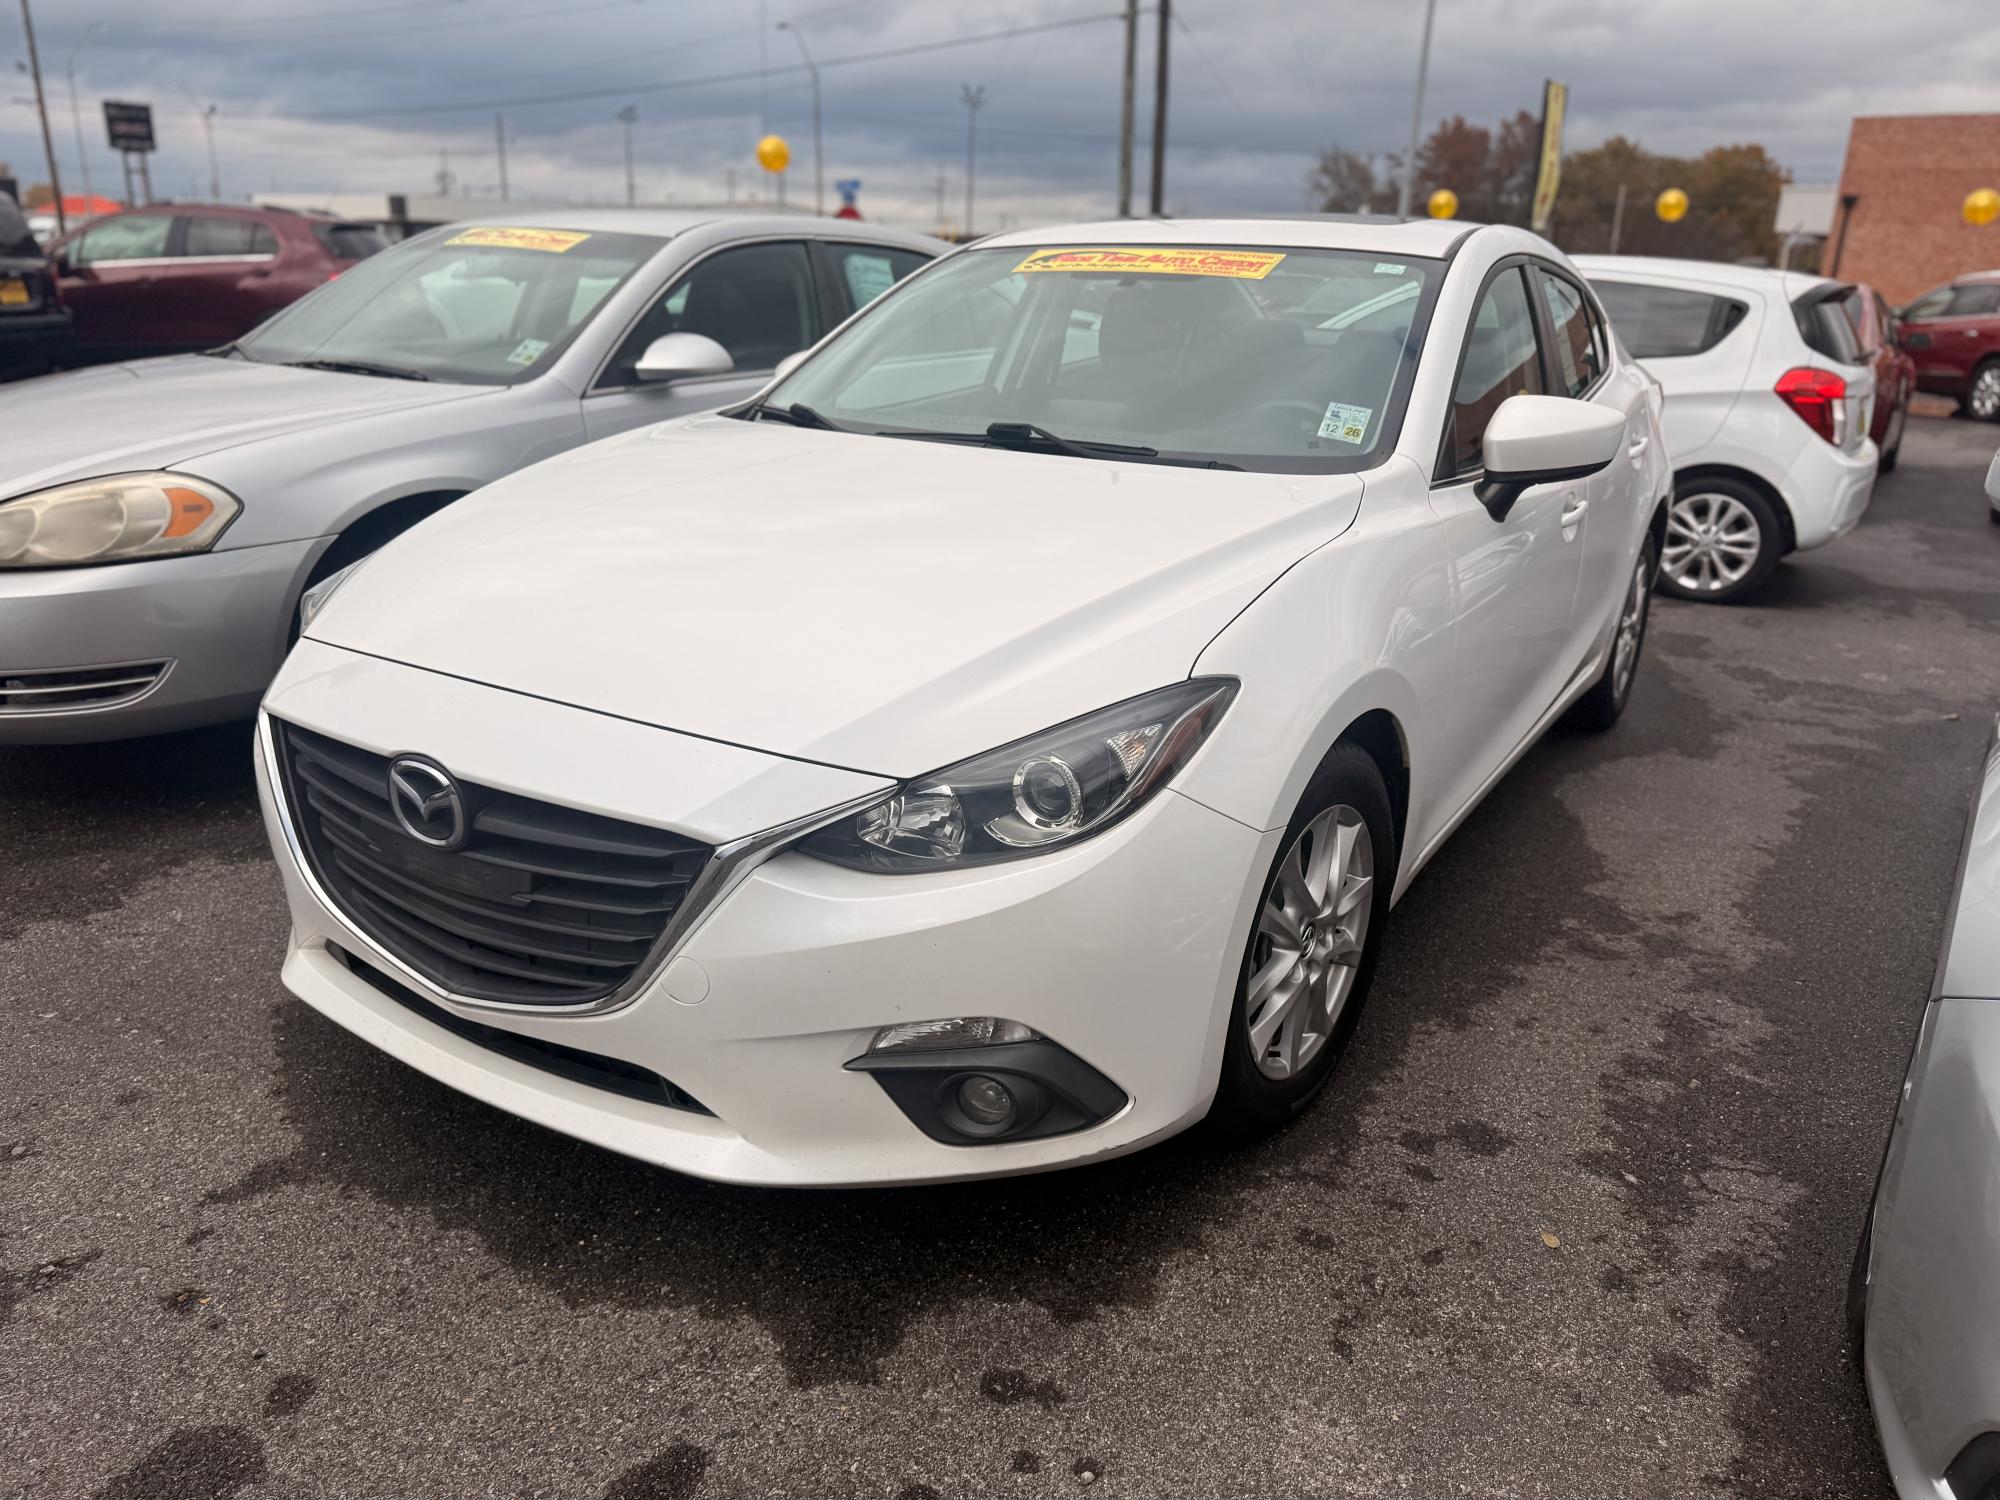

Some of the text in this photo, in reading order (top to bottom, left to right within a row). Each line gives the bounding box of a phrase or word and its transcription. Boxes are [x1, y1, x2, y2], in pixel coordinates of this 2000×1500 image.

[1213, 252, 1277, 260] PROTECTION
[1141, 254, 1196, 266] AUTO
[1199, 255, 1272, 270] CREDIT
[1325, 423, 1338, 434] 12
[1344, 427, 1361, 437] 26
